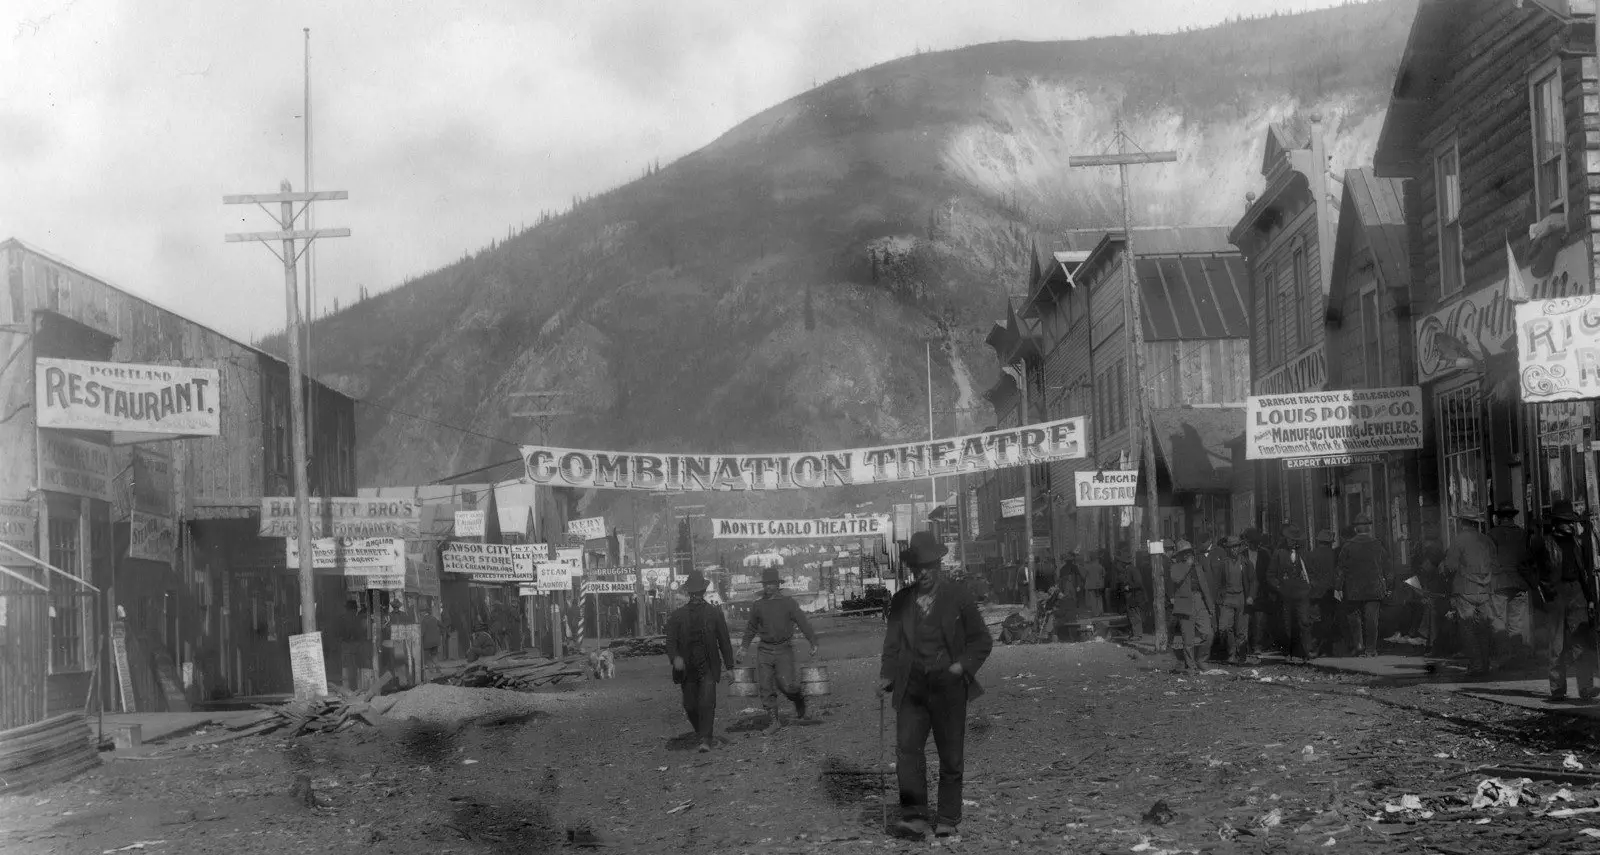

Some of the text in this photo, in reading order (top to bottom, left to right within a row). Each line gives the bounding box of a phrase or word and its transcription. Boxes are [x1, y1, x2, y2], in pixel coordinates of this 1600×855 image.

[89, 365, 173, 382] PORTLAND
[46, 366, 213, 422] RESTAURANT.
[1258, 390, 1410, 408] BRANCH FACTORY & SALESROOM
[1256, 408, 1318, 426] LOUIS
[1321, 404, 1373, 422] POND
[1388, 401, 1419, 416] CO.
[1271, 424, 1360, 443] MANUFACTURING
[1360, 420, 1422, 437] JEWELERS.
[1258, 445, 1276, 455] Fine
[1275, 441, 1310, 454] Diamond
[1310, 440, 1333, 452] Work
[1333, 440, 1343, 450] &
[1341, 438, 1371, 449] Native
[1370, 437, 1389, 449] Gold
[527, 422, 1078, 490] COMBINATION THEATRE
[1287, 458, 1321, 468] EXPERT
[719, 518, 878, 535] MONTE CARLO THEATRE
[449, 543, 509, 554] AWSON CITY
[444, 554, 511, 565] CIGAR STORE
[465, 562, 486, 571] CREAM
[541, 568, 567, 576] STEAM
